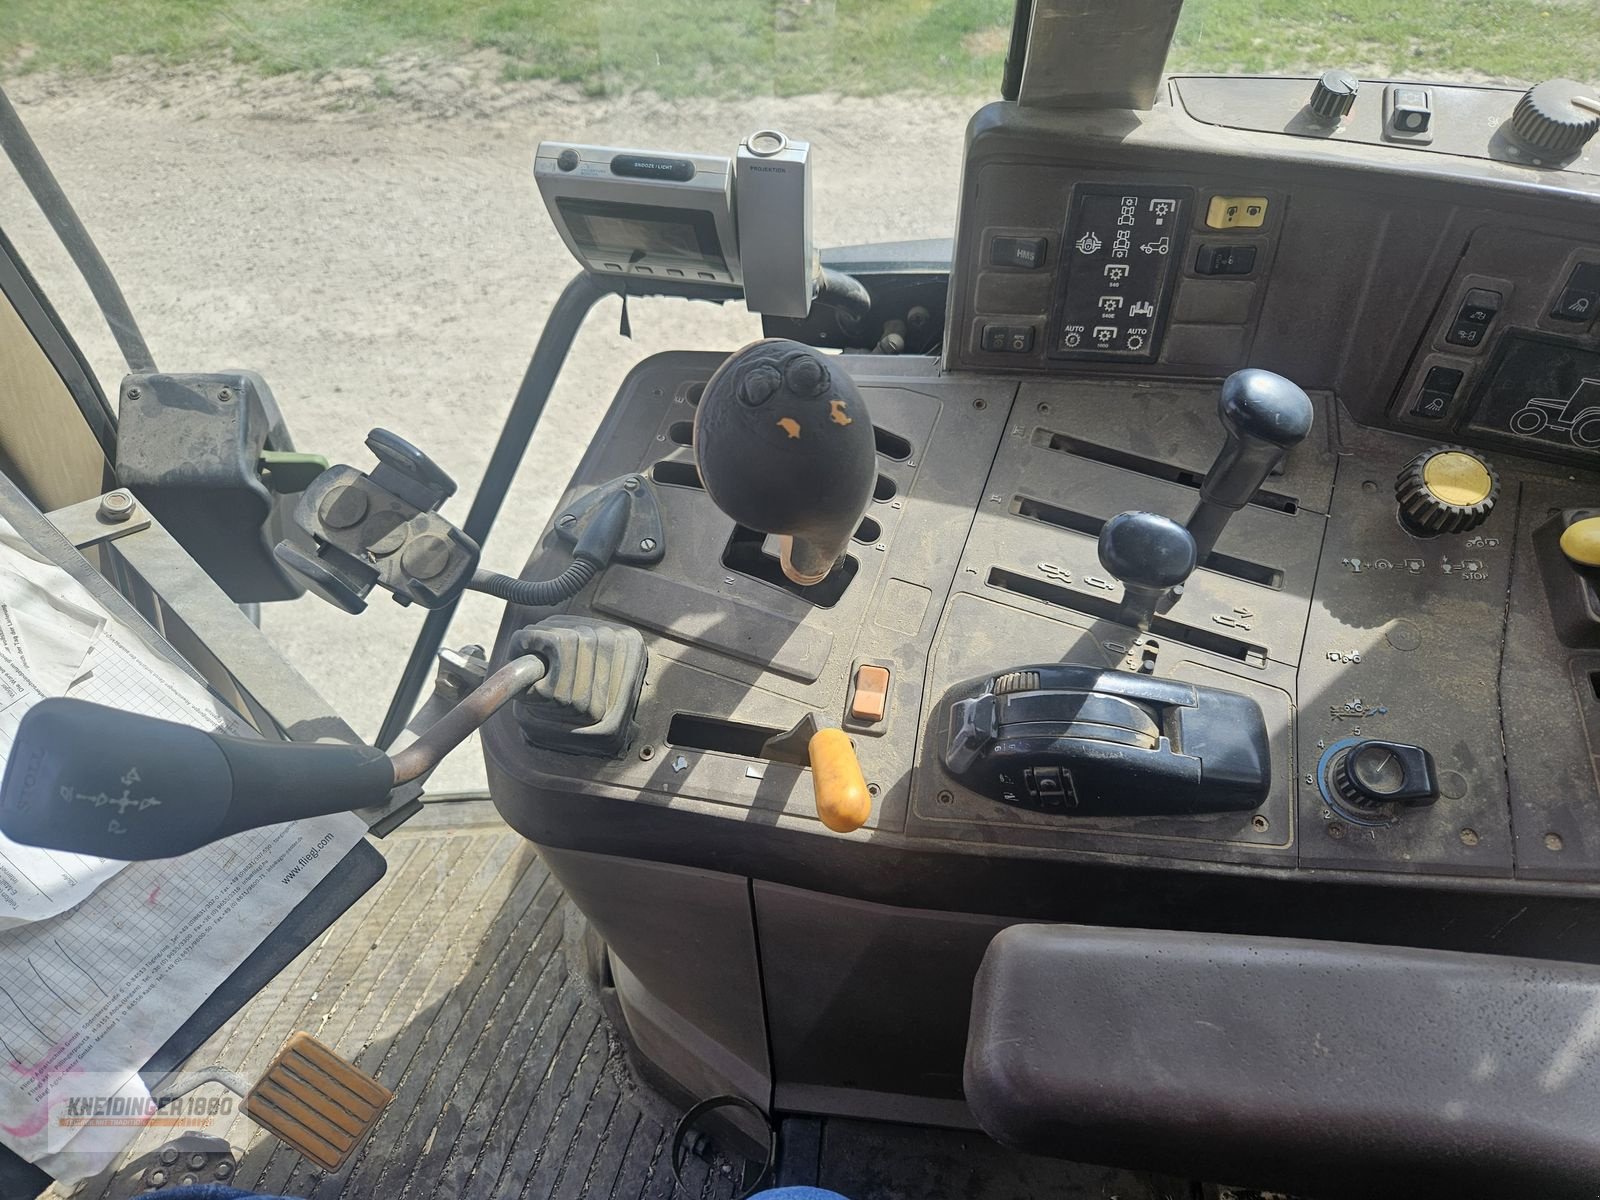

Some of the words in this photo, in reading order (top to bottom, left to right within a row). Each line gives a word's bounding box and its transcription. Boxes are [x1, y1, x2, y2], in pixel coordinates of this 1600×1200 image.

[750, 165, 786, 174] PROJEKTION
[1016, 248, 1035, 261] HMS
[1064, 325, 1085, 333] AUTO
[1461, 572, 1489, 581] STOP
[1353, 726, 1361, 736] 5
[1317, 739, 1325, 749] 4
[1306, 773, 1314, 785] 3
[1323, 809, 1331, 819] 2
[281, 831, 335, 886] www.fliegl.com
